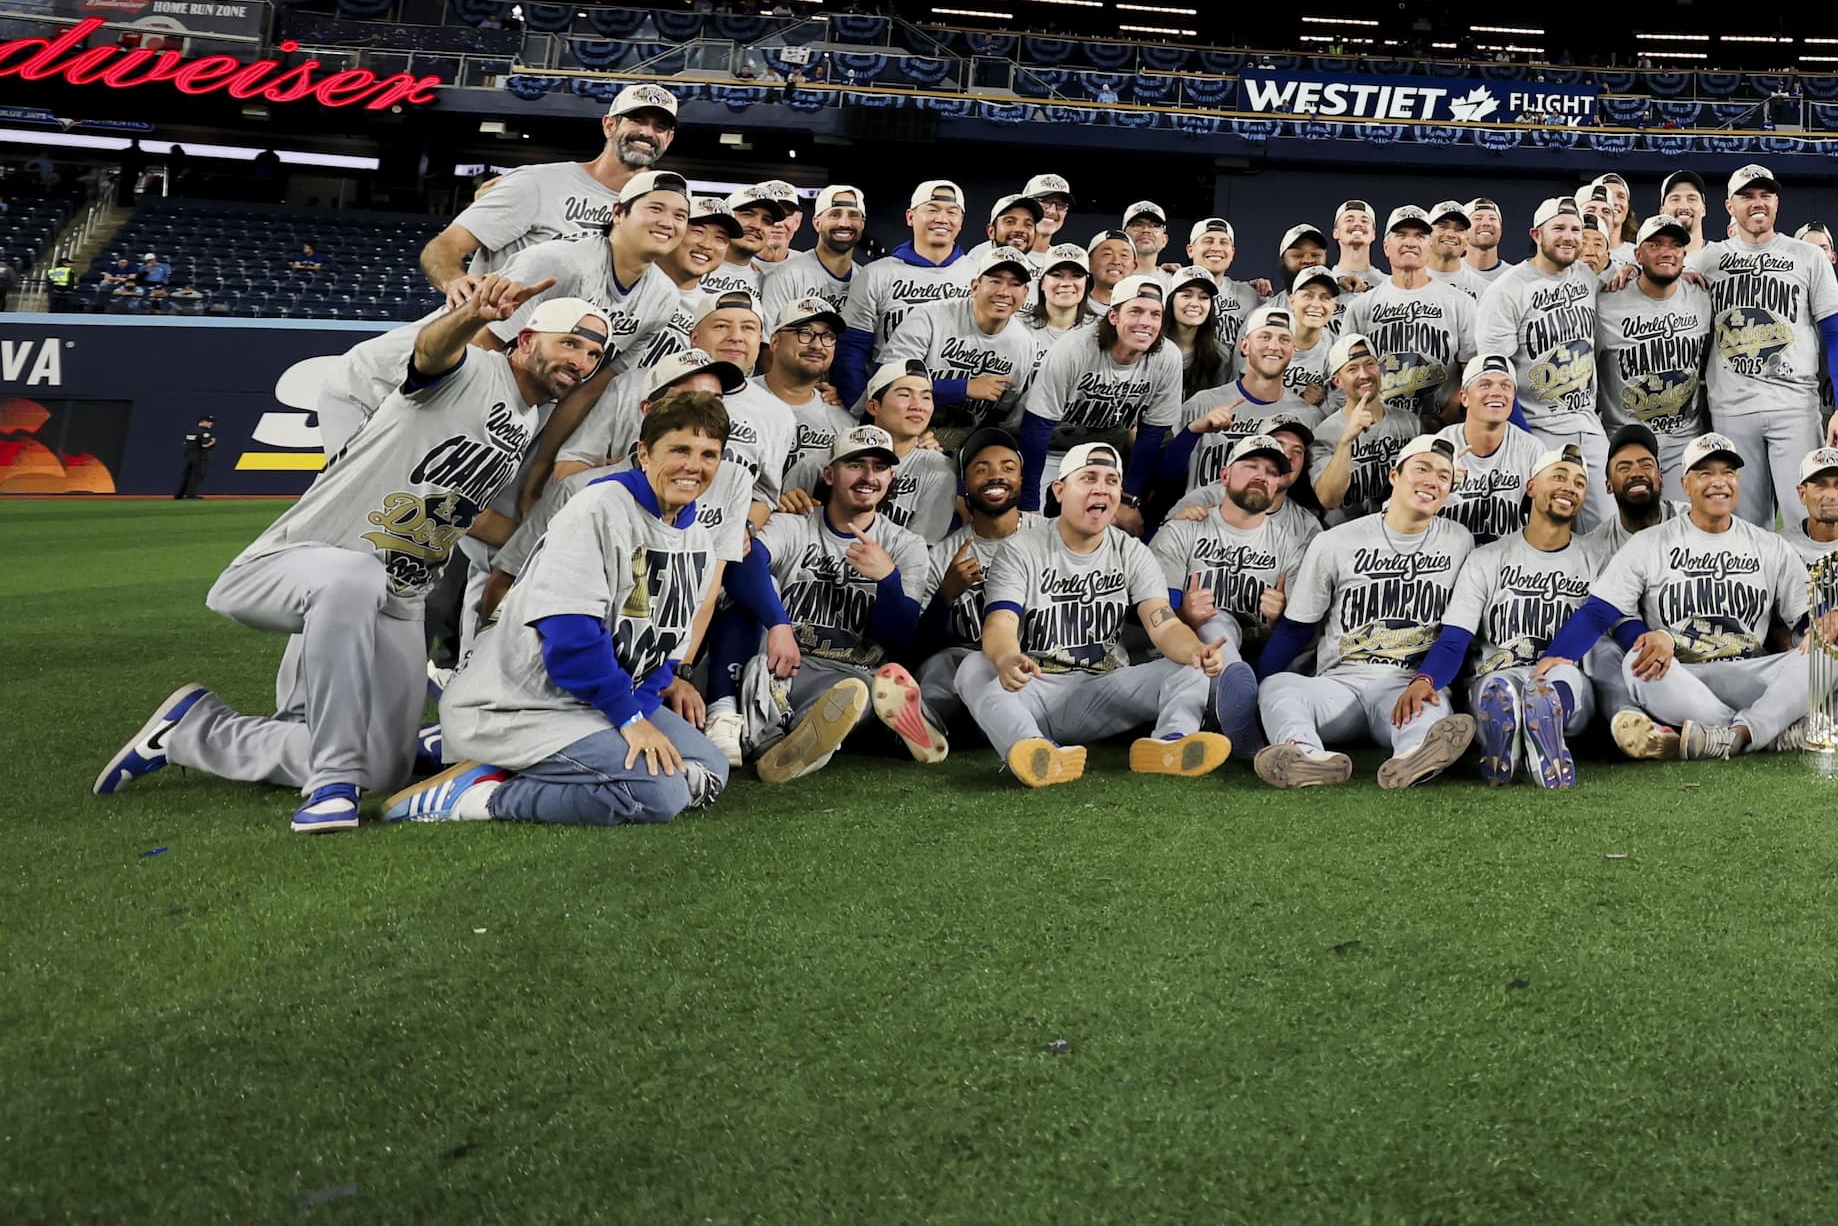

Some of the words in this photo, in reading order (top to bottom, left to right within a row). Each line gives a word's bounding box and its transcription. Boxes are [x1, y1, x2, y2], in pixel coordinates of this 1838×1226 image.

[152, 1, 188, 14] HOME
[189, 3, 214, 16] RUN
[215, 5, 247, 18] ZONE
[1243, 78, 1448, 121] WESTJET
[1509, 92, 1595, 116] FLIGHT
[893, 280, 941, 300] World
[1711, 274, 1800, 323] CHAMPIONS
[1733, 358, 1762, 375] 2025
[1566, 392, 1590, 411] 2025
[1653, 415, 1682, 431] 2025
[1194, 538, 1237, 561] World
[1230, 545, 1276, 573] Series
[1354, 548, 1410, 574] World
[1402, 551, 1451, 582] Series
[1669, 547, 1718, 570] World
[1713, 550, 1759, 579] Series
[1081, 568, 1125, 604] Serie
[1501, 566, 1549, 588] World
[1659, 577, 1767, 632] CHAMPIONS
